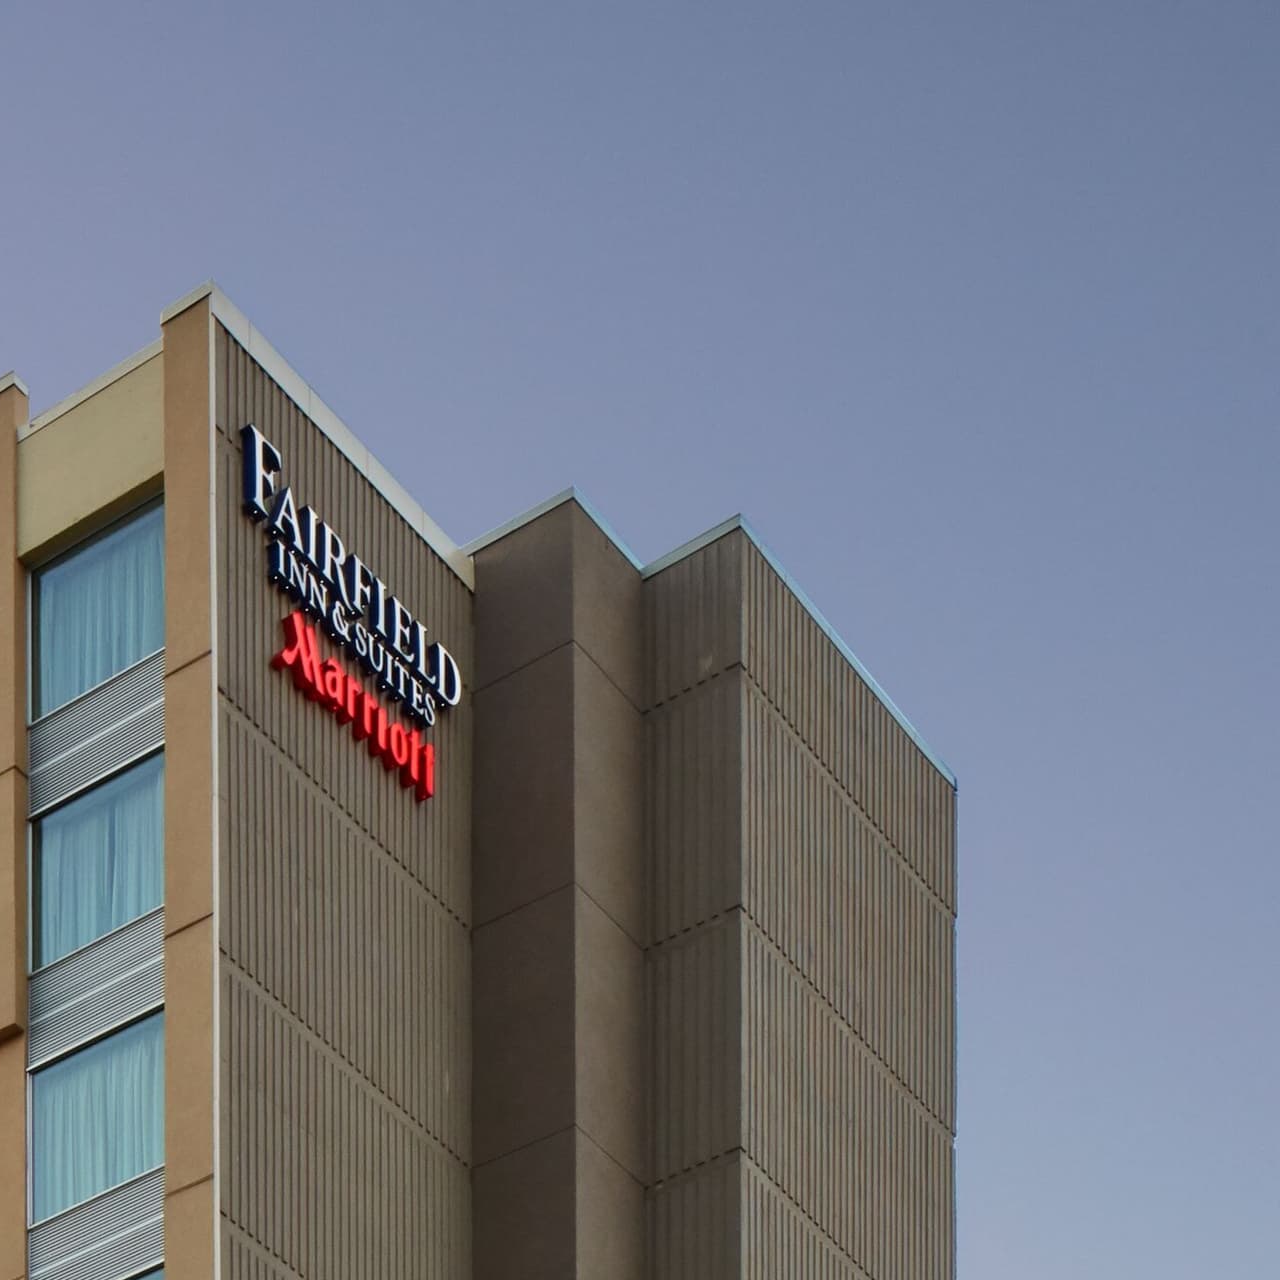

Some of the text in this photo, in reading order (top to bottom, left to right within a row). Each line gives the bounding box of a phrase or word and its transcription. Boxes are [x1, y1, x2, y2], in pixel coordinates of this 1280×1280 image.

[241, 424, 462, 707] FAIRFIELD
[274, 540, 328, 615] INN
[352, 620, 437, 728] SUITES
[273, 609, 436, 799] Marriott
